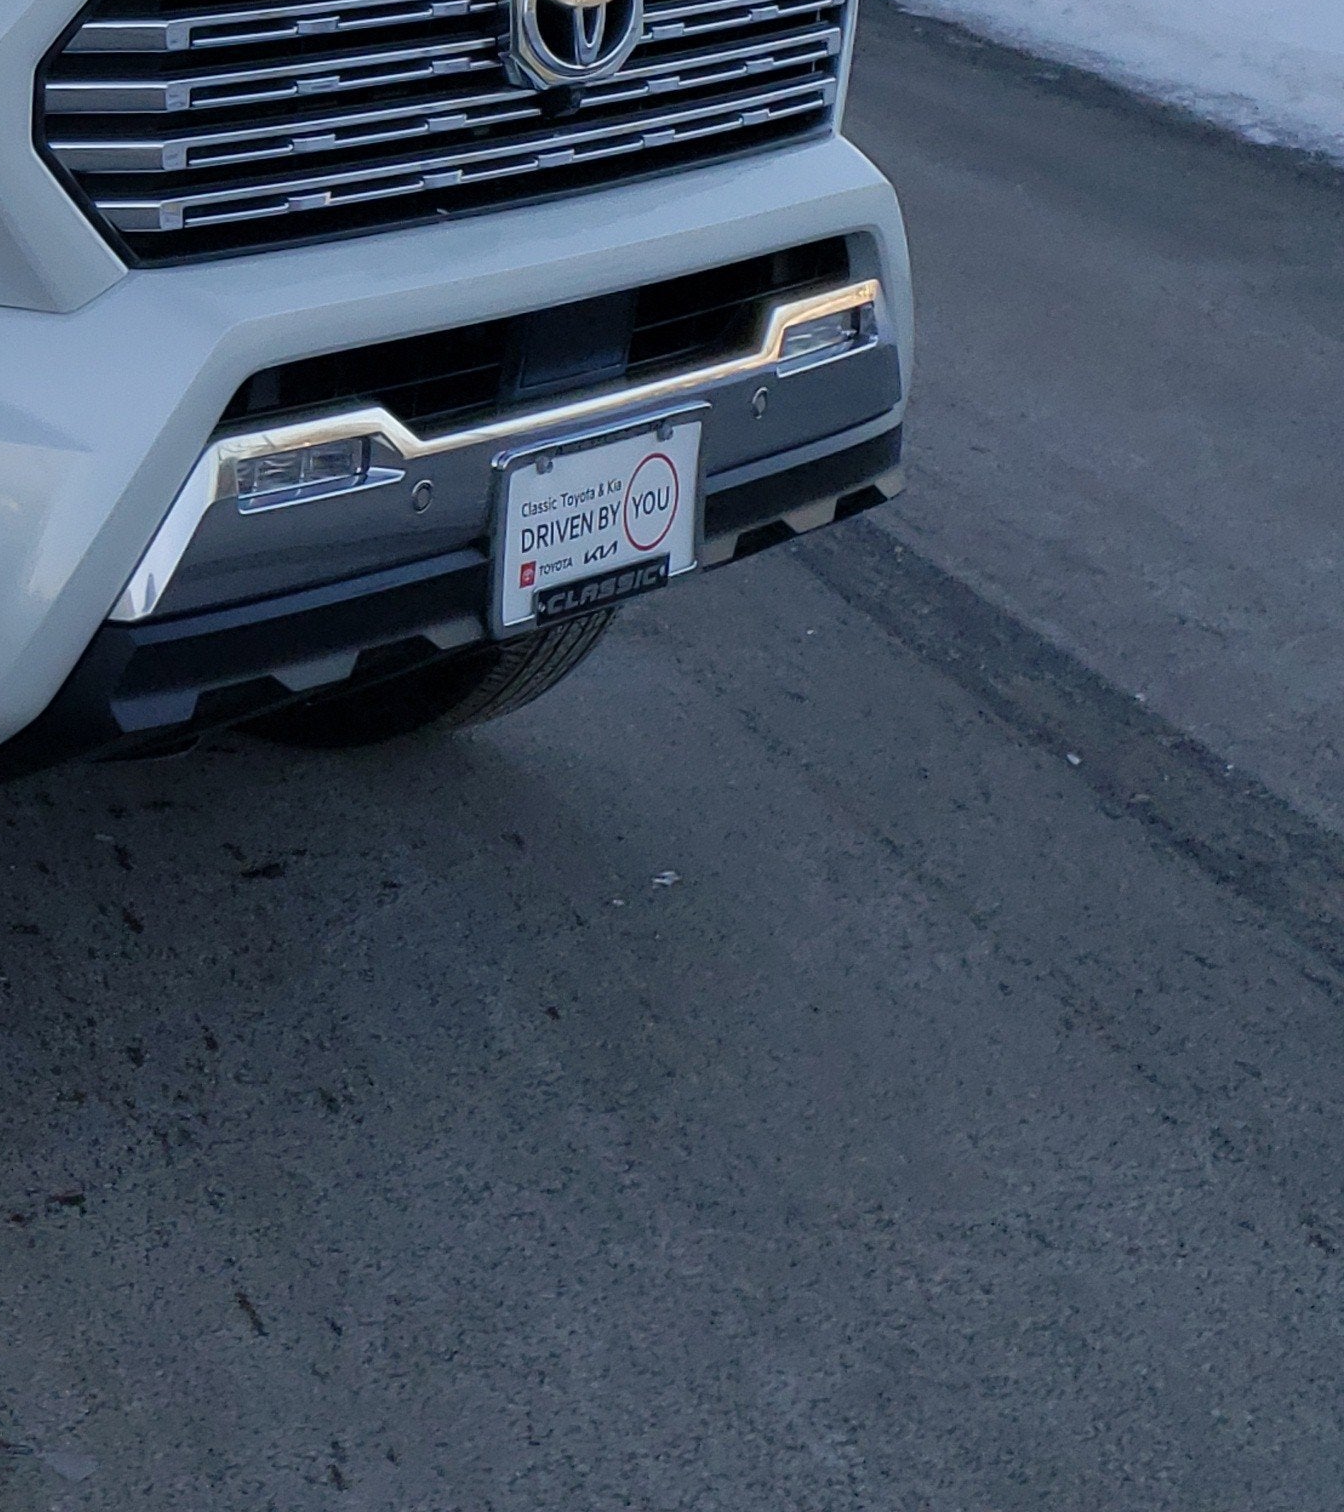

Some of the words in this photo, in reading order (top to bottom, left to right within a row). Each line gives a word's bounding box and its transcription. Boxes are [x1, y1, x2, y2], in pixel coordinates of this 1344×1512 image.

[521, 496, 558, 518] Classic
[561, 487, 596, 508] Toyota
[597, 482, 605, 498] &
[606, 478, 622, 494] Kia
[521, 511, 593, 554] DRIVEN
[598, 500, 622, 531] BY
[632, 486, 671, 520] YOU
[538, 558, 573, 577] TOYOTA
[545, 564, 662, 615] CLASSIC
